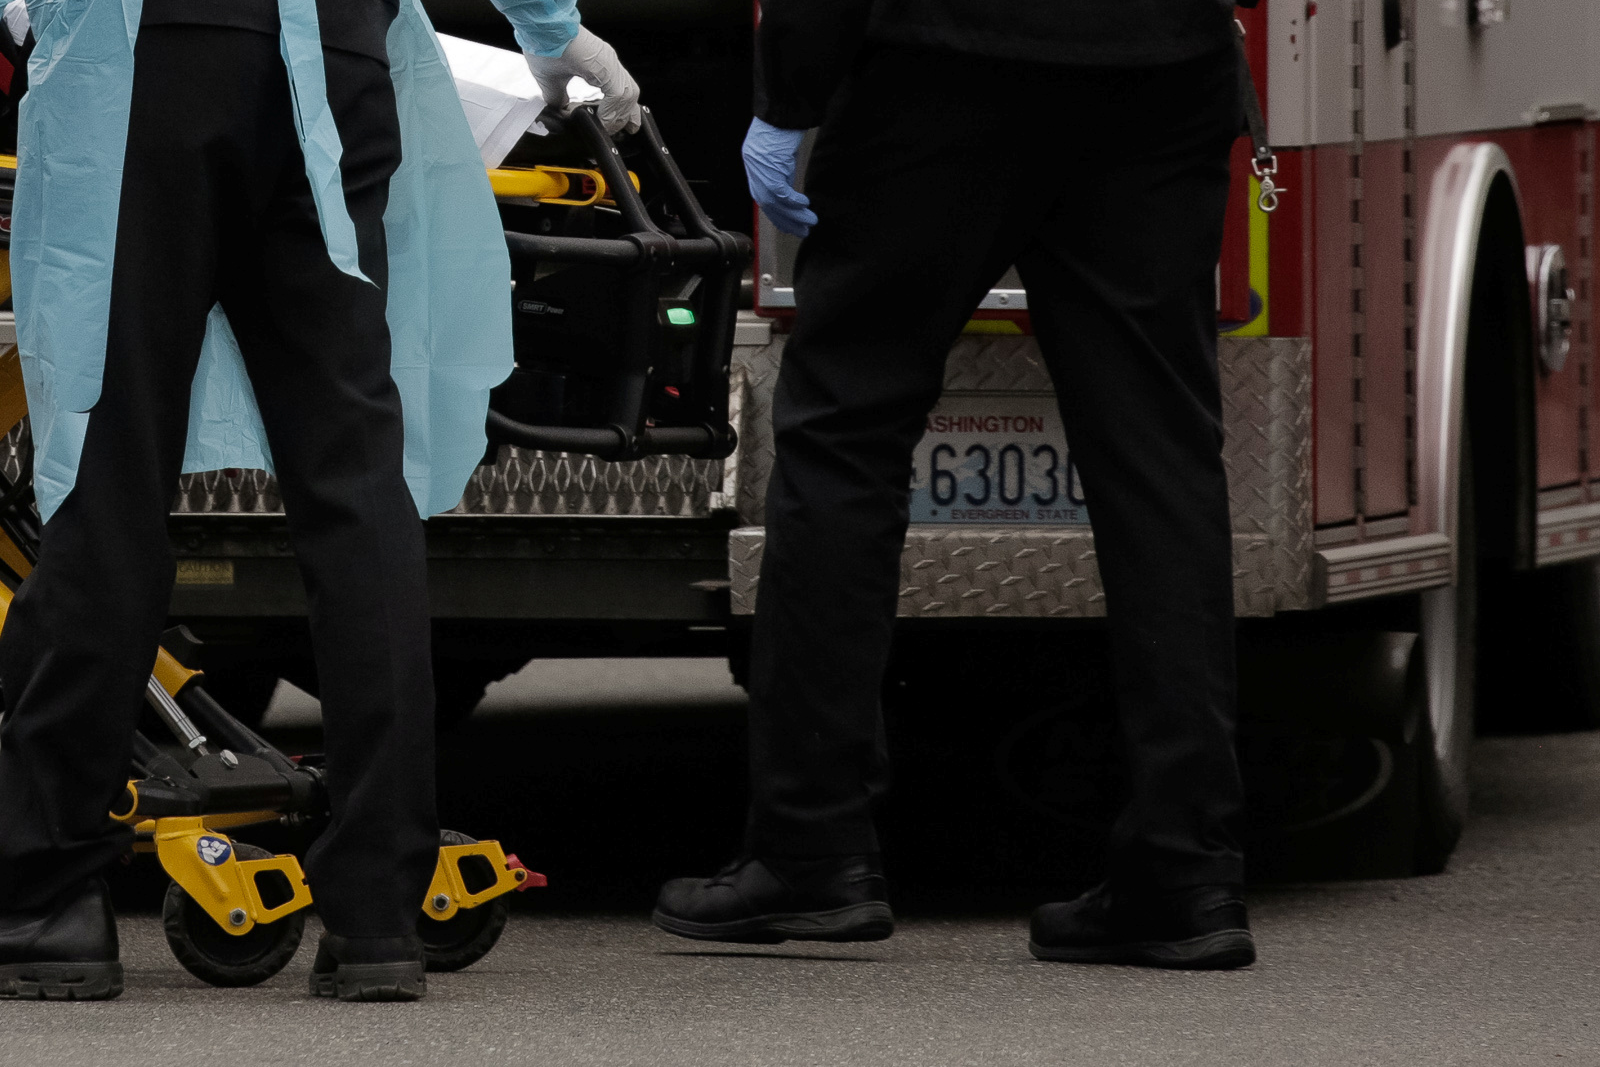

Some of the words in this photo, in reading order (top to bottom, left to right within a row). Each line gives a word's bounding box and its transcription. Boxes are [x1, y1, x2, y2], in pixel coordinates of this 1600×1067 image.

[925, 415, 1044, 433] ASHINGTON
[952, 509, 1030, 520] EVERGREEN
[1037, 509, 1078, 520] STATE
